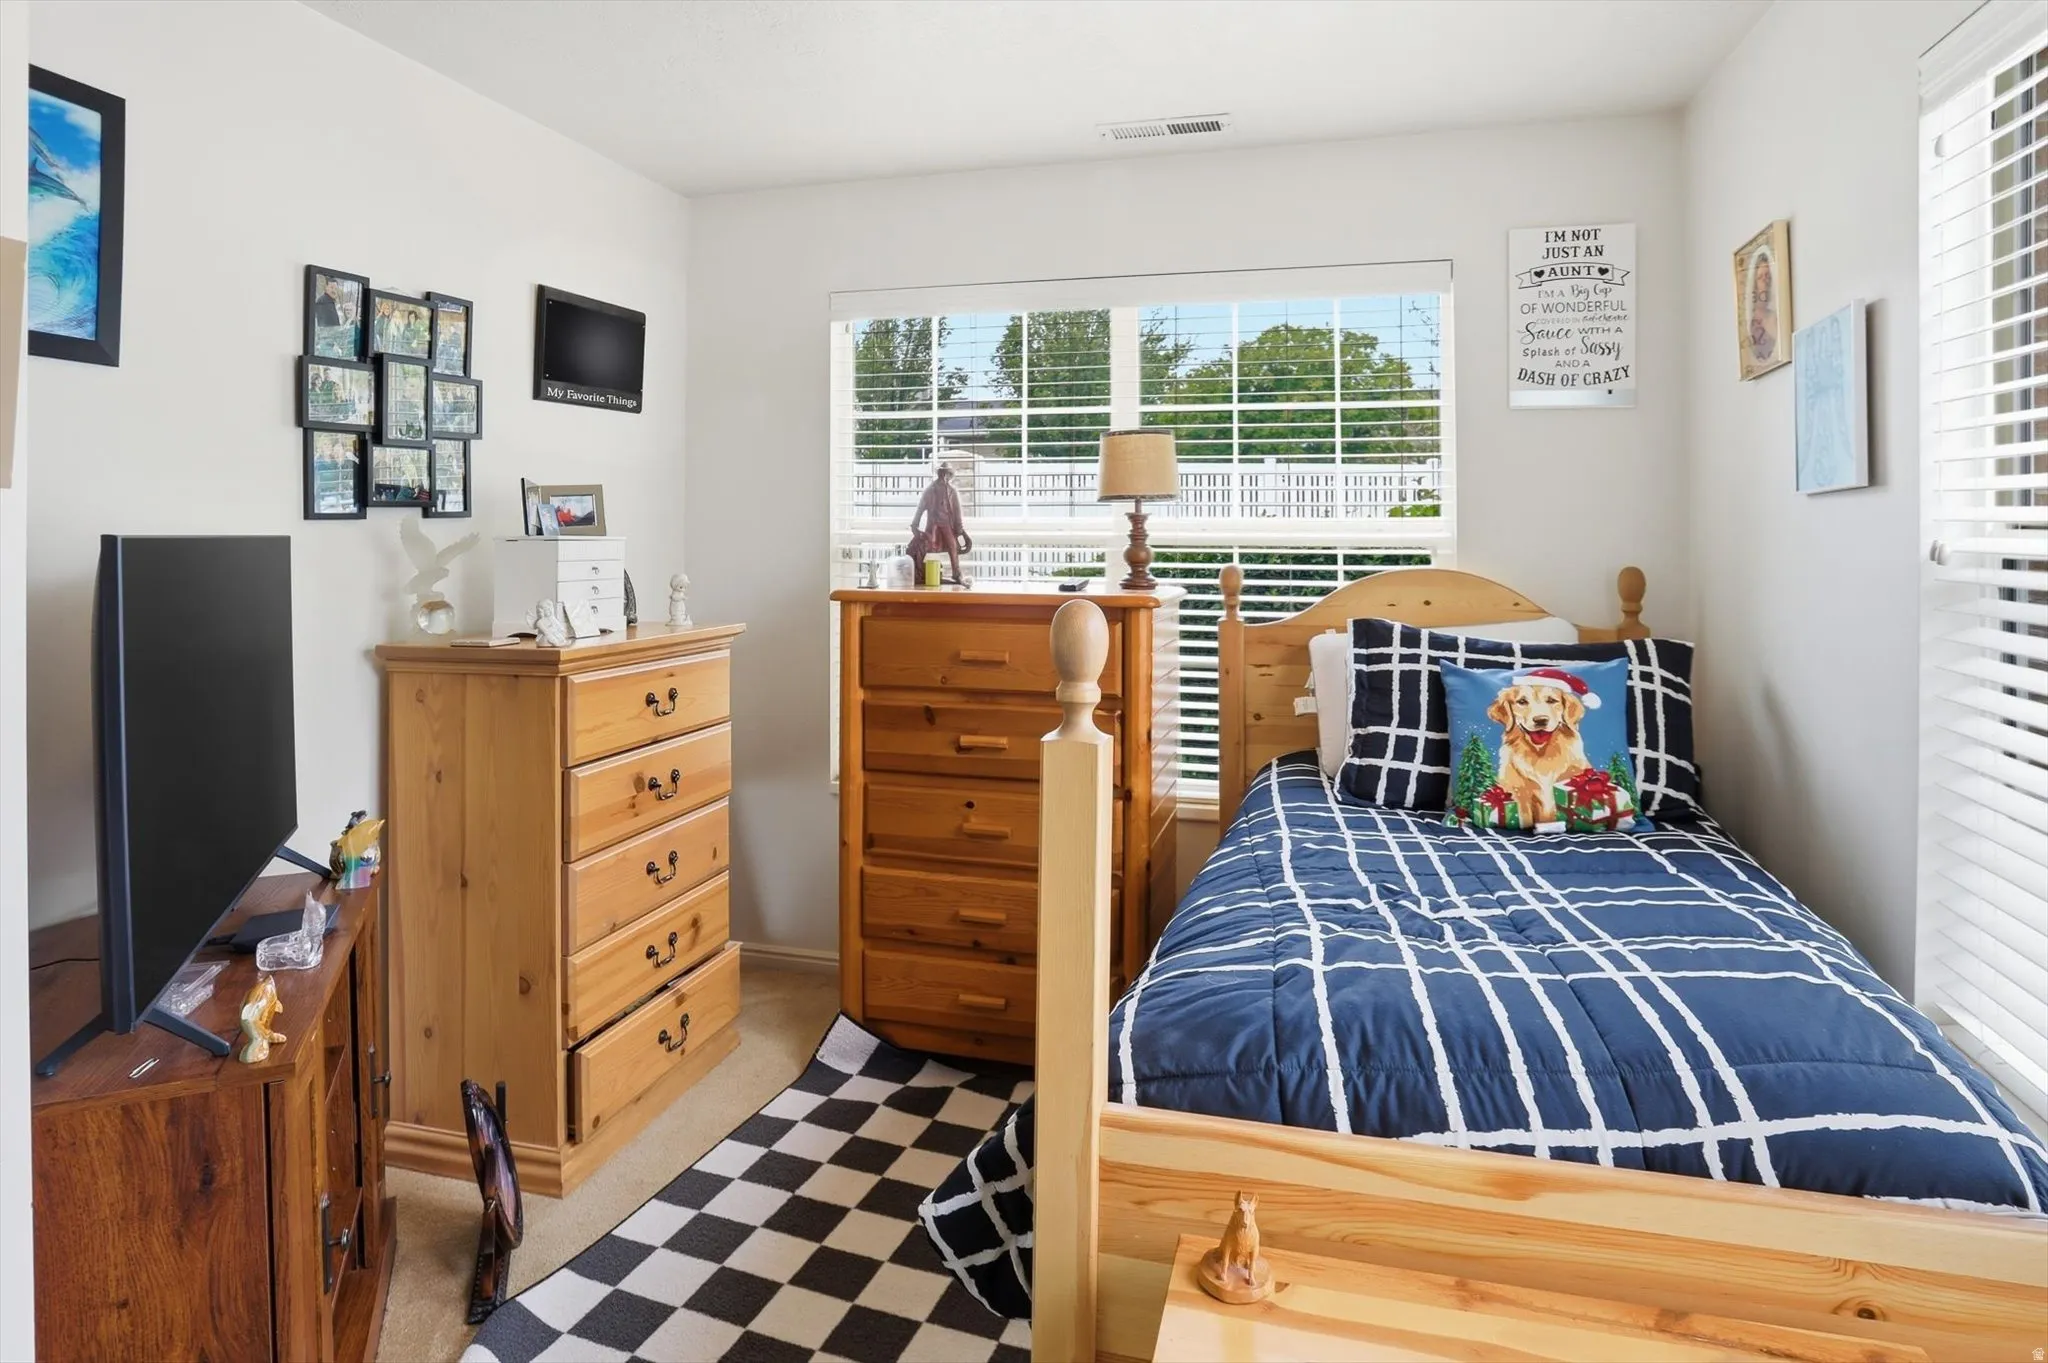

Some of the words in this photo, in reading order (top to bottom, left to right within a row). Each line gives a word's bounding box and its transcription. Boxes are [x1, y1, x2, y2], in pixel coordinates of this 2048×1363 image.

[1545, 230, 1566, 243] I'M
[1571, 228, 1601, 241] NOT
[1542, 246, 1581, 259] JUST
[1583, 245, 1604, 257] AN
[1548, 266, 1595, 277] AUNT
[1557, 289, 1566, 297] A
[1571, 284, 1590, 300] Big
[1520, 303, 1537, 314] OF
[1541, 300, 1627, 315] WONDERFUL
[1518, 322, 1573, 345] Sauce
[1578, 327, 1611, 335] WITH
[1564, 346, 1577, 356] of
[1580, 336, 1621, 361] Sassy
[1555, 360, 1580, 368] AND
[1517, 368, 1556, 386] DASH
[1560, 373, 1580, 387] OF
[1583, 365, 1630, 386] CRAZY
[547, 386, 564, 399] My
[567, 389, 605, 402] Favorite
[607, 394, 637, 408] Things
